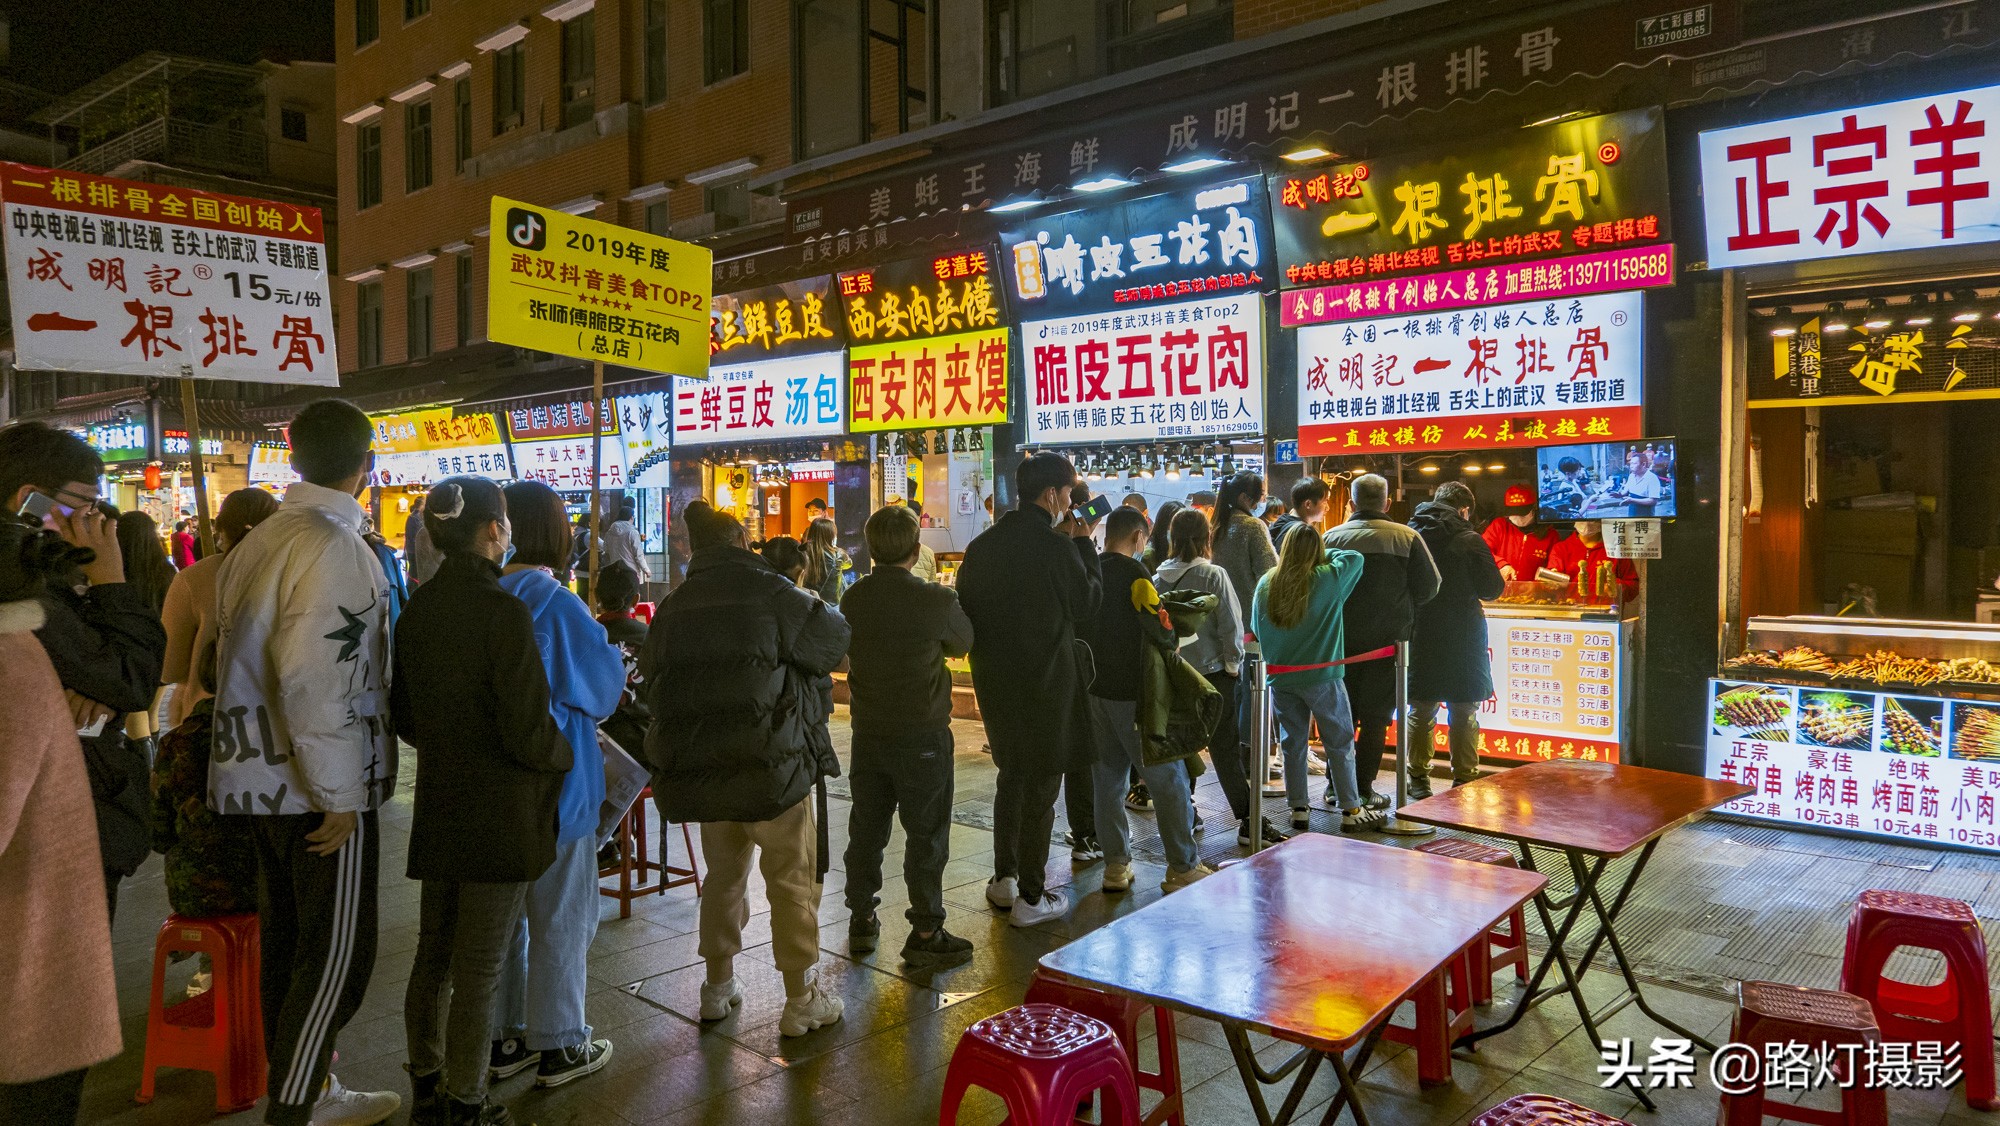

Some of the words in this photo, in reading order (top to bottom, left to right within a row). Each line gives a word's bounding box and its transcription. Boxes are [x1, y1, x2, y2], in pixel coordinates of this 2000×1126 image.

[1641, 25, 1706, 46] 13797003065
[1660, 8, 1706, 30] 七彩遮阳
[869, 137, 1100, 220] 美蚝王海鲜
[1725, 100, 1990, 252] 正宗羊
[12, 176, 313, 235] 一根排骨全国创始人
[1321, 151, 1600, 244] 一根排骨
[13, 208, 97, 245] 中央电视台
[100, 219, 164, 252] 湖北经视
[171, 226, 258, 264] 舌尖上的武汉
[265, 240, 320, 271] 专题报道
[566, 230, 670, 273] 2019年度
[802, 227, 888, 263] 西安肉夹馍
[1286, 255, 1366, 284] 中央电视台
[1368, 245, 1440, 273] 湖北经视
[1447, 230, 1563, 264] 舌尖上的武汉
[1571, 215, 1659, 247] 专题报道
[510, 253, 703, 312] 武汉抖音美食TOP2
[934, 251, 988, 280] 老潼关
[224, 272, 322, 308] 15元/份
[841, 273, 872, 295] 正宗
[1294, 269, 1499, 320] 全国一根排骨创始人总店
[1505, 253, 1667, 295] 加盟热线:13971159588
[529, 299, 680, 346] 张师傅脆皮五花肉
[721, 291, 834, 350] 三鲜豆皮
[849, 275, 998, 339] 西安肉夹馍
[1051, 325, 1068, 336] 抖音
[1071, 303, 1239, 335] 2019年度武汉抖音美食Top2
[1342, 300, 1585, 346] 全国一根排骨创始人总店
[27, 298, 325, 373] 一根排骨
[850, 336, 1007, 423] 西安肉夹馍
[1033, 325, 1249, 406] 脆皮五花肉
[676, 380, 774, 433] 三鲜豆皮
[785, 373, 840, 426] 汤包
[1037, 397, 1251, 431] 张师傅脆皮五花肉创始人
[1309, 397, 1378, 421] 中央电视台
[1382, 391, 1440, 415] 湖北经视
[1449, 385, 1545, 411] 舌尖上的武汉
[1555, 379, 1626, 404] 专题报道
[424, 415, 495, 443] 脆皮五花肉
[1317, 426, 1444, 448] 一直被模仿
[1463, 417, 1614, 441] 从未被超越
[437, 453, 506, 475] 脆皮五花肉
[1613, 521, 1649, 534] 招聘
[1617, 535, 1644, 545] 员工
[1579, 650, 1610, 662] 7元/串
[1584, 635, 1610, 646] 20元
[1578, 683, 1609, 695] 6元/串
[1579, 666, 1609, 678] 7元/串
[1578, 698, 1609, 710] 3元/串
[1578, 714, 1609, 726] 3元/串
[1731, 741, 1768, 761] 正宗
[1808, 749, 1853, 773] 豪佳
[1720, 759, 1782, 799] 羊肉串
[1888, 758, 1930, 781] 绝味
[1794, 771, 1858, 807] 烤肉串
[1872, 779, 1939, 818] 烤面筋
[1795, 807, 1859, 828] 10元3串
[1874, 818, 1938, 838] 10元4串
[1949, 828, 2000, 847] 10元3
